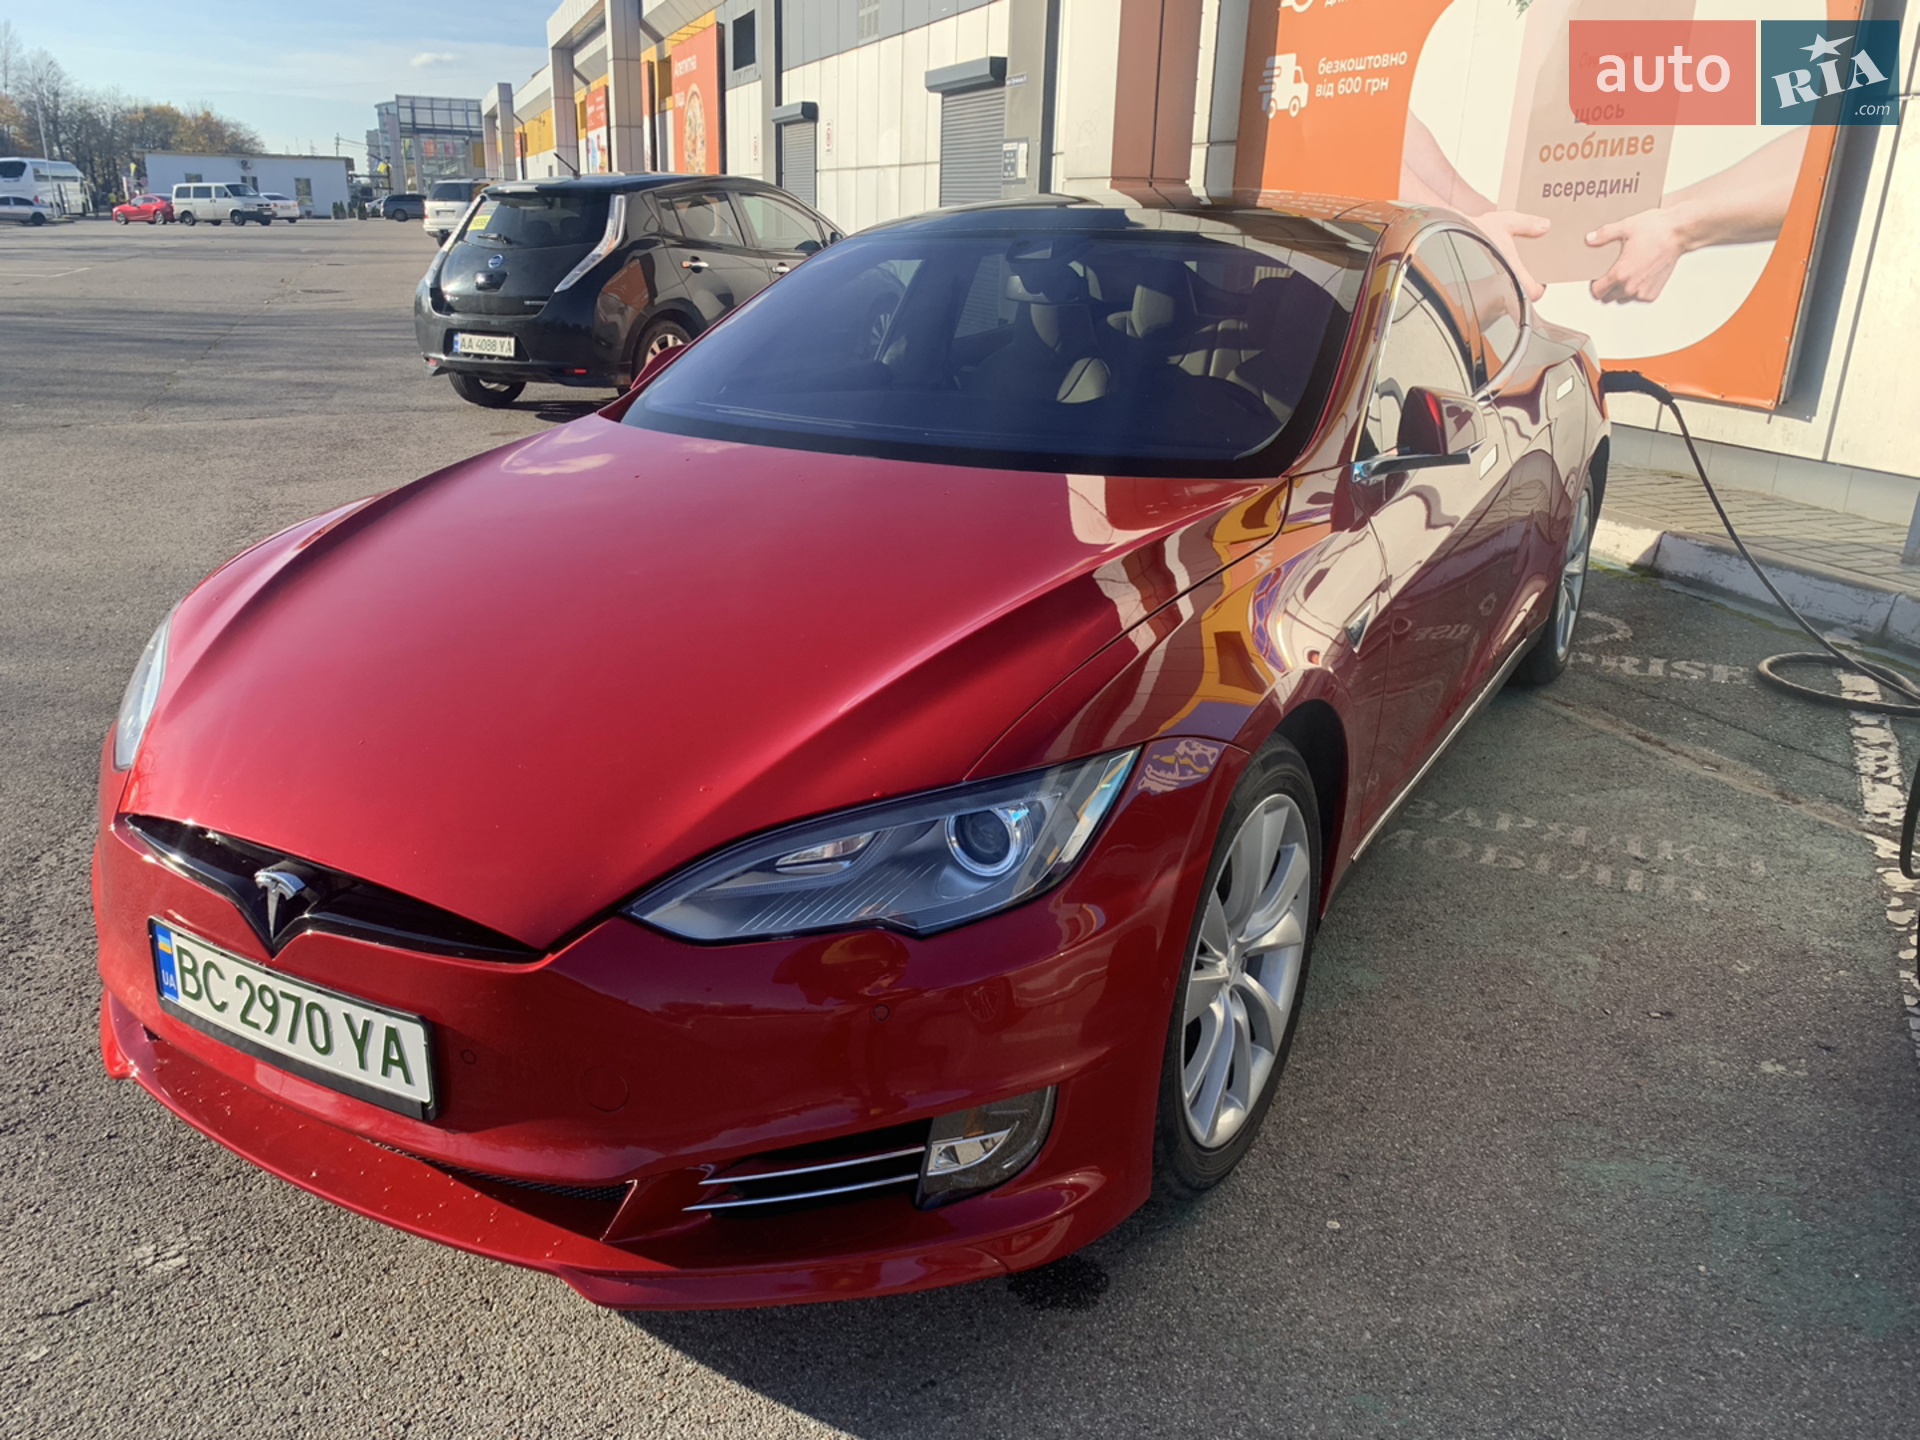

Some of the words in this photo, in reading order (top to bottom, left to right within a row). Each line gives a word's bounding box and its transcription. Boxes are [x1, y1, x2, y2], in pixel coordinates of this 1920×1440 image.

[1317, 51, 1408, 75] безкоштовно
[1315, 79, 1335, 98] від
[1337, 76, 1362, 95] 600
[1364, 77, 1390, 96] грн
[1573, 103, 1626, 125] щось
[1538, 131, 1656, 163] особливе
[1541, 171, 1641, 202] всередині
[161, 969, 177, 991] UA
[176, 944, 228, 1014] BC
[235, 974, 335, 1057] 2970
[343, 1011, 414, 1086] YA
